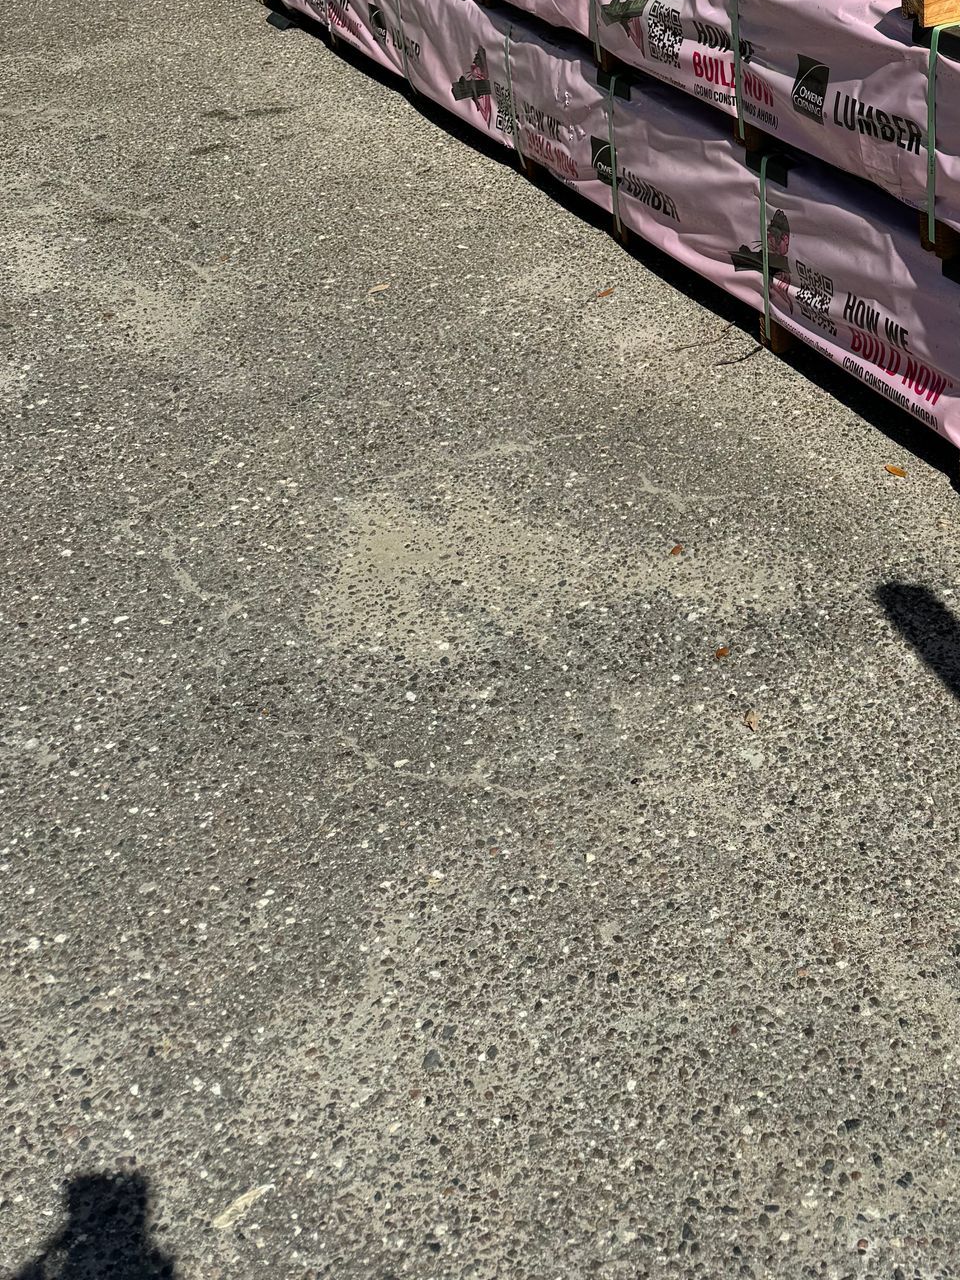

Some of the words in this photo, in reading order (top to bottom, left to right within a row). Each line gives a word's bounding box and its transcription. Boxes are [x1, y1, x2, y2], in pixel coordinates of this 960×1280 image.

[692, 20, 731, 53] HOW
[692, 52, 736, 89] BUIL
[793, 94, 821, 118] CORNING
[800, 86, 823, 107] OWENS
[834, 90, 923, 156] LUMBER
[622, 167, 681, 223] LUMBER
[843, 291, 881, 337] HOW
[884, 317, 913, 355] WE
[849, 326, 901, 377] BUILD
[842, 356, 864, 379] (COMO
[864, 371, 910, 409] CONSTRUIMOS
[911, 402, 938, 430] AHORA)
